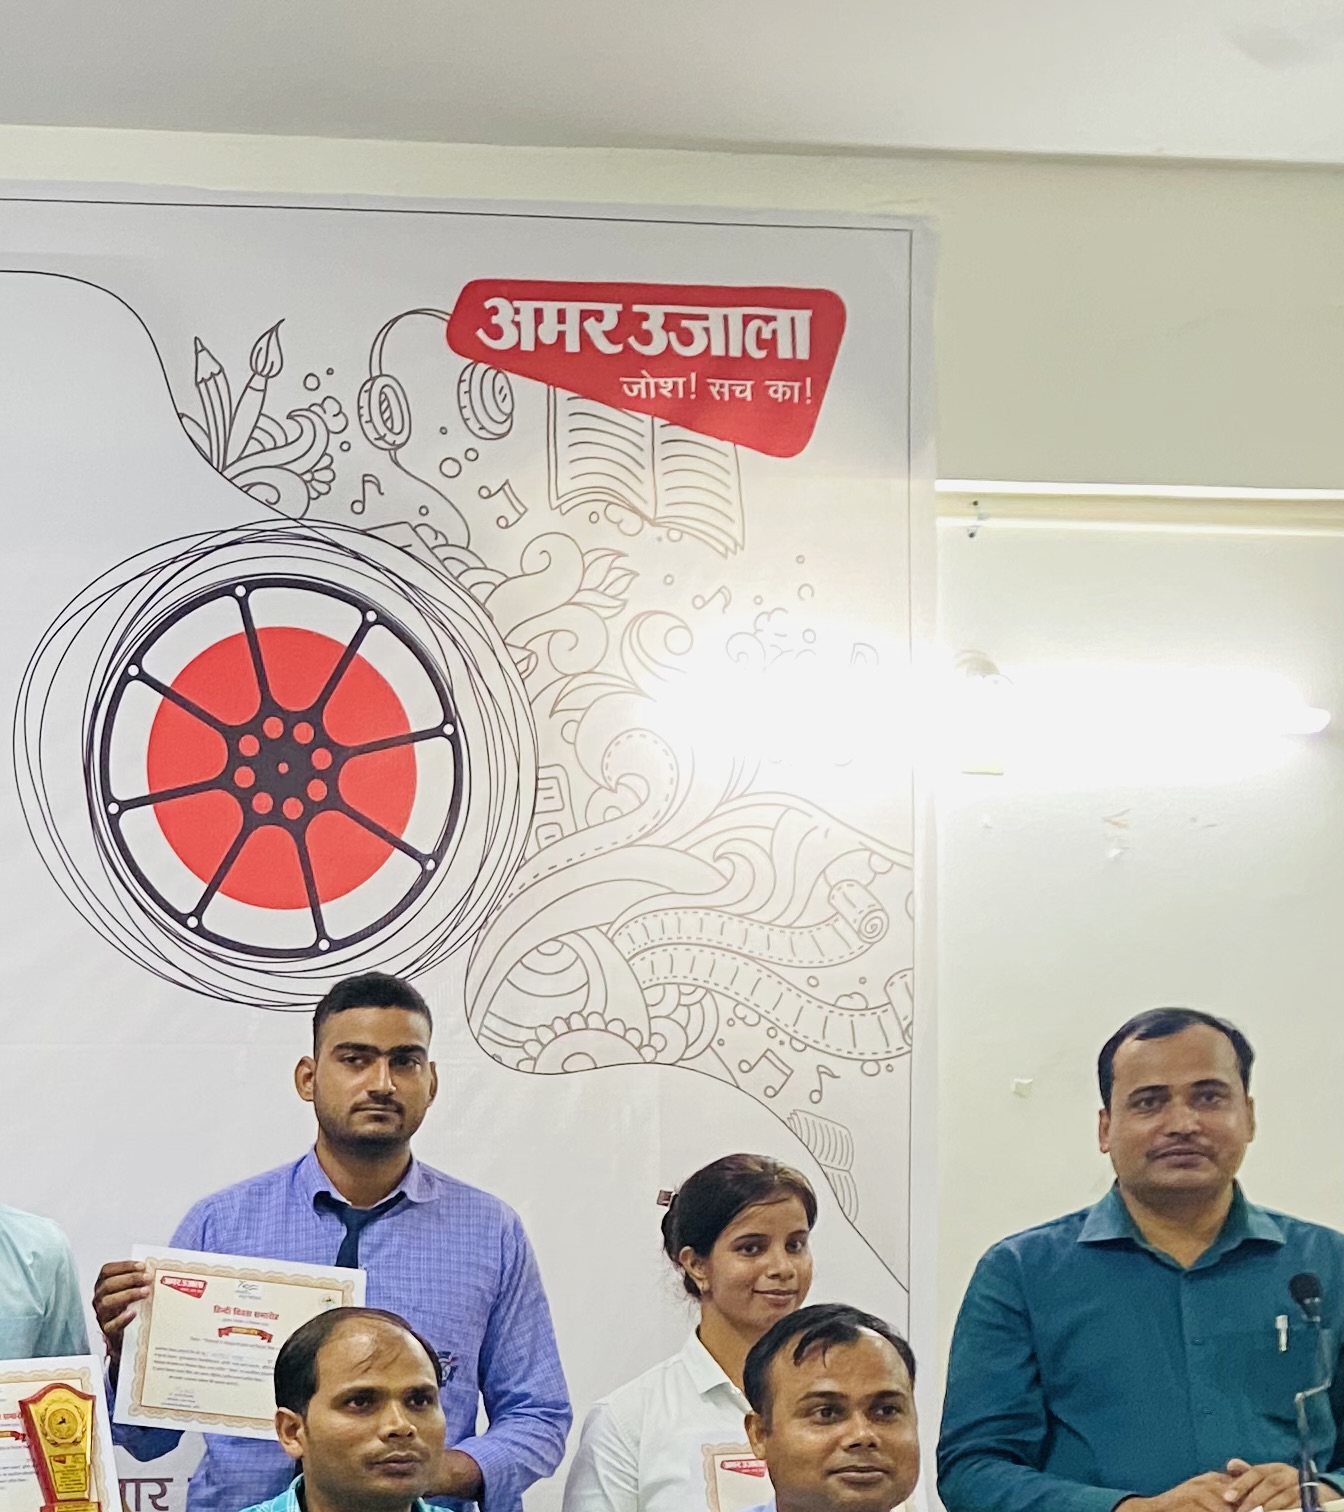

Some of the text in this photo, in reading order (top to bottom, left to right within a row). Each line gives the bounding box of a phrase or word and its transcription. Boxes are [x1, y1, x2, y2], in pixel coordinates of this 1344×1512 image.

[475, 297, 813, 361] अमर उजाला
[619, 369, 813, 405] जोश! सच का!
